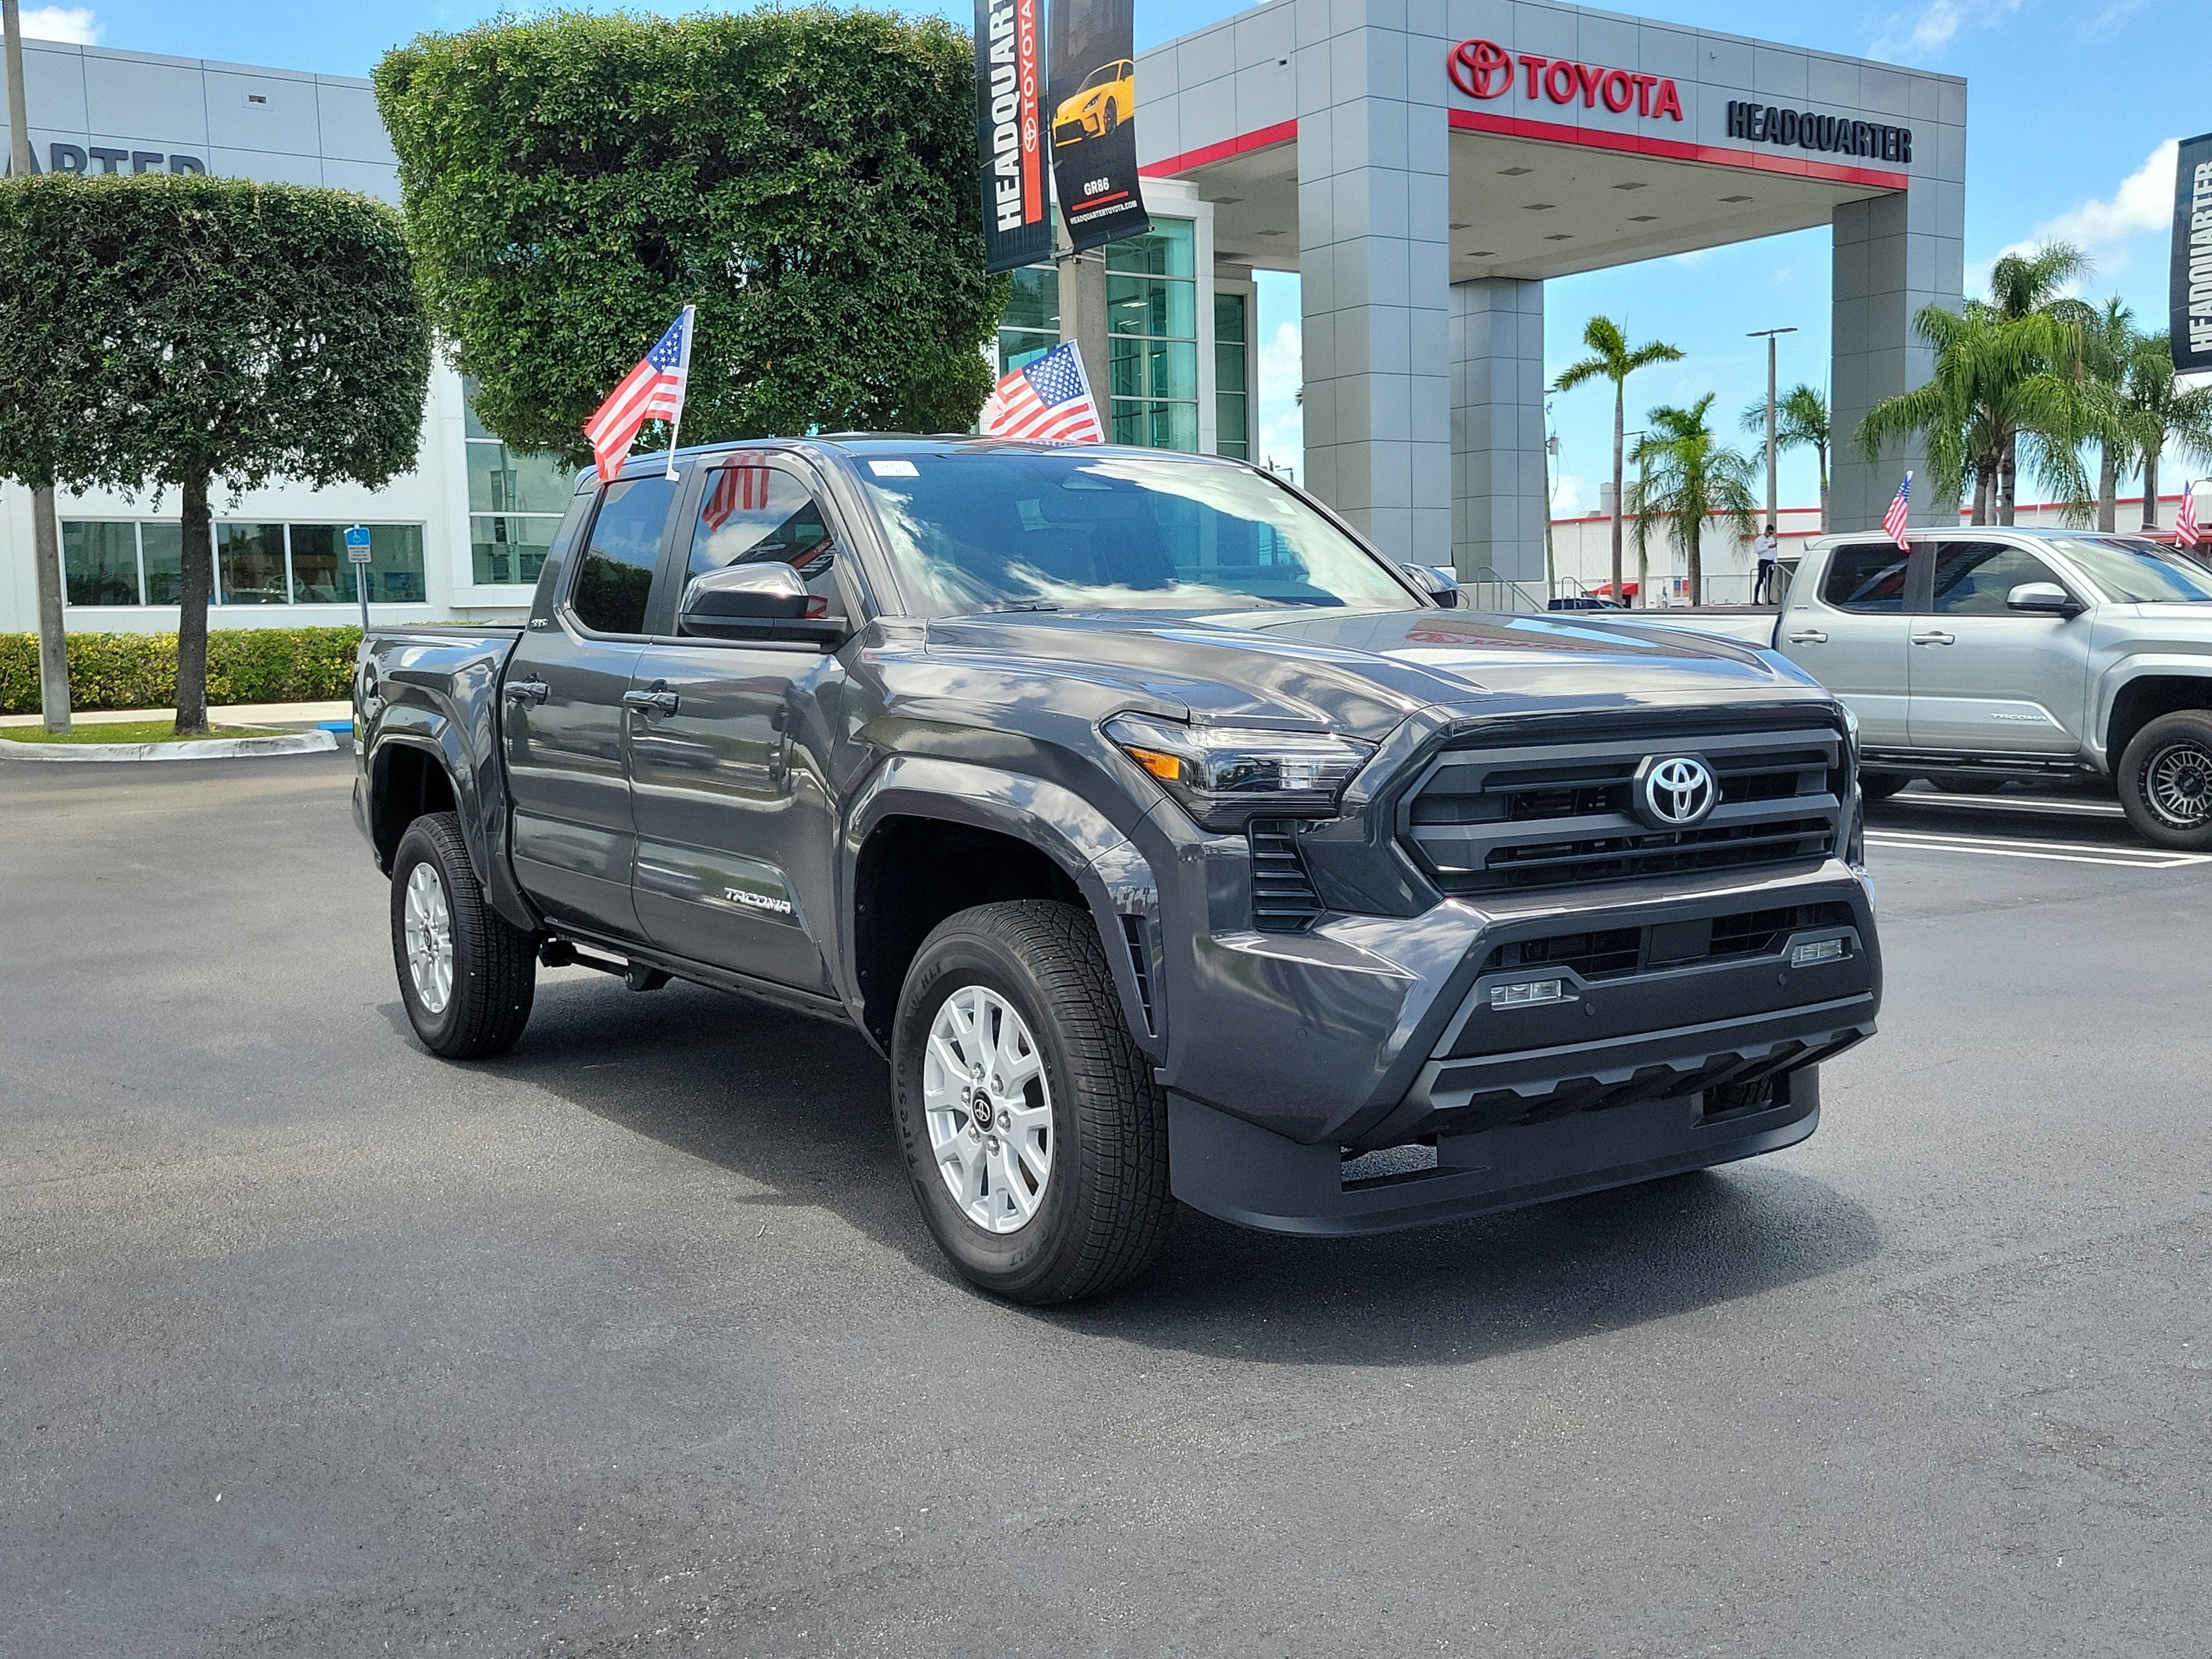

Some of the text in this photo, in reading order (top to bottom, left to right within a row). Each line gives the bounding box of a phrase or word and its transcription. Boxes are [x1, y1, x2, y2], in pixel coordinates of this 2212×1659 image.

[1021, 0, 1035, 116] TOYOTA
[1519, 55, 1683, 121] TOYOTA
[1728, 100, 1912, 163] HEADQUARTER
[5, 140, 206, 175] RTE
[1084, 177, 1110, 195] GR86
[1070, 200, 1138, 225] HEADQUARTERTOYOTA.COM
[1990, 713, 2047, 721] TACOMA
[724, 887, 791, 914] TACOMA
